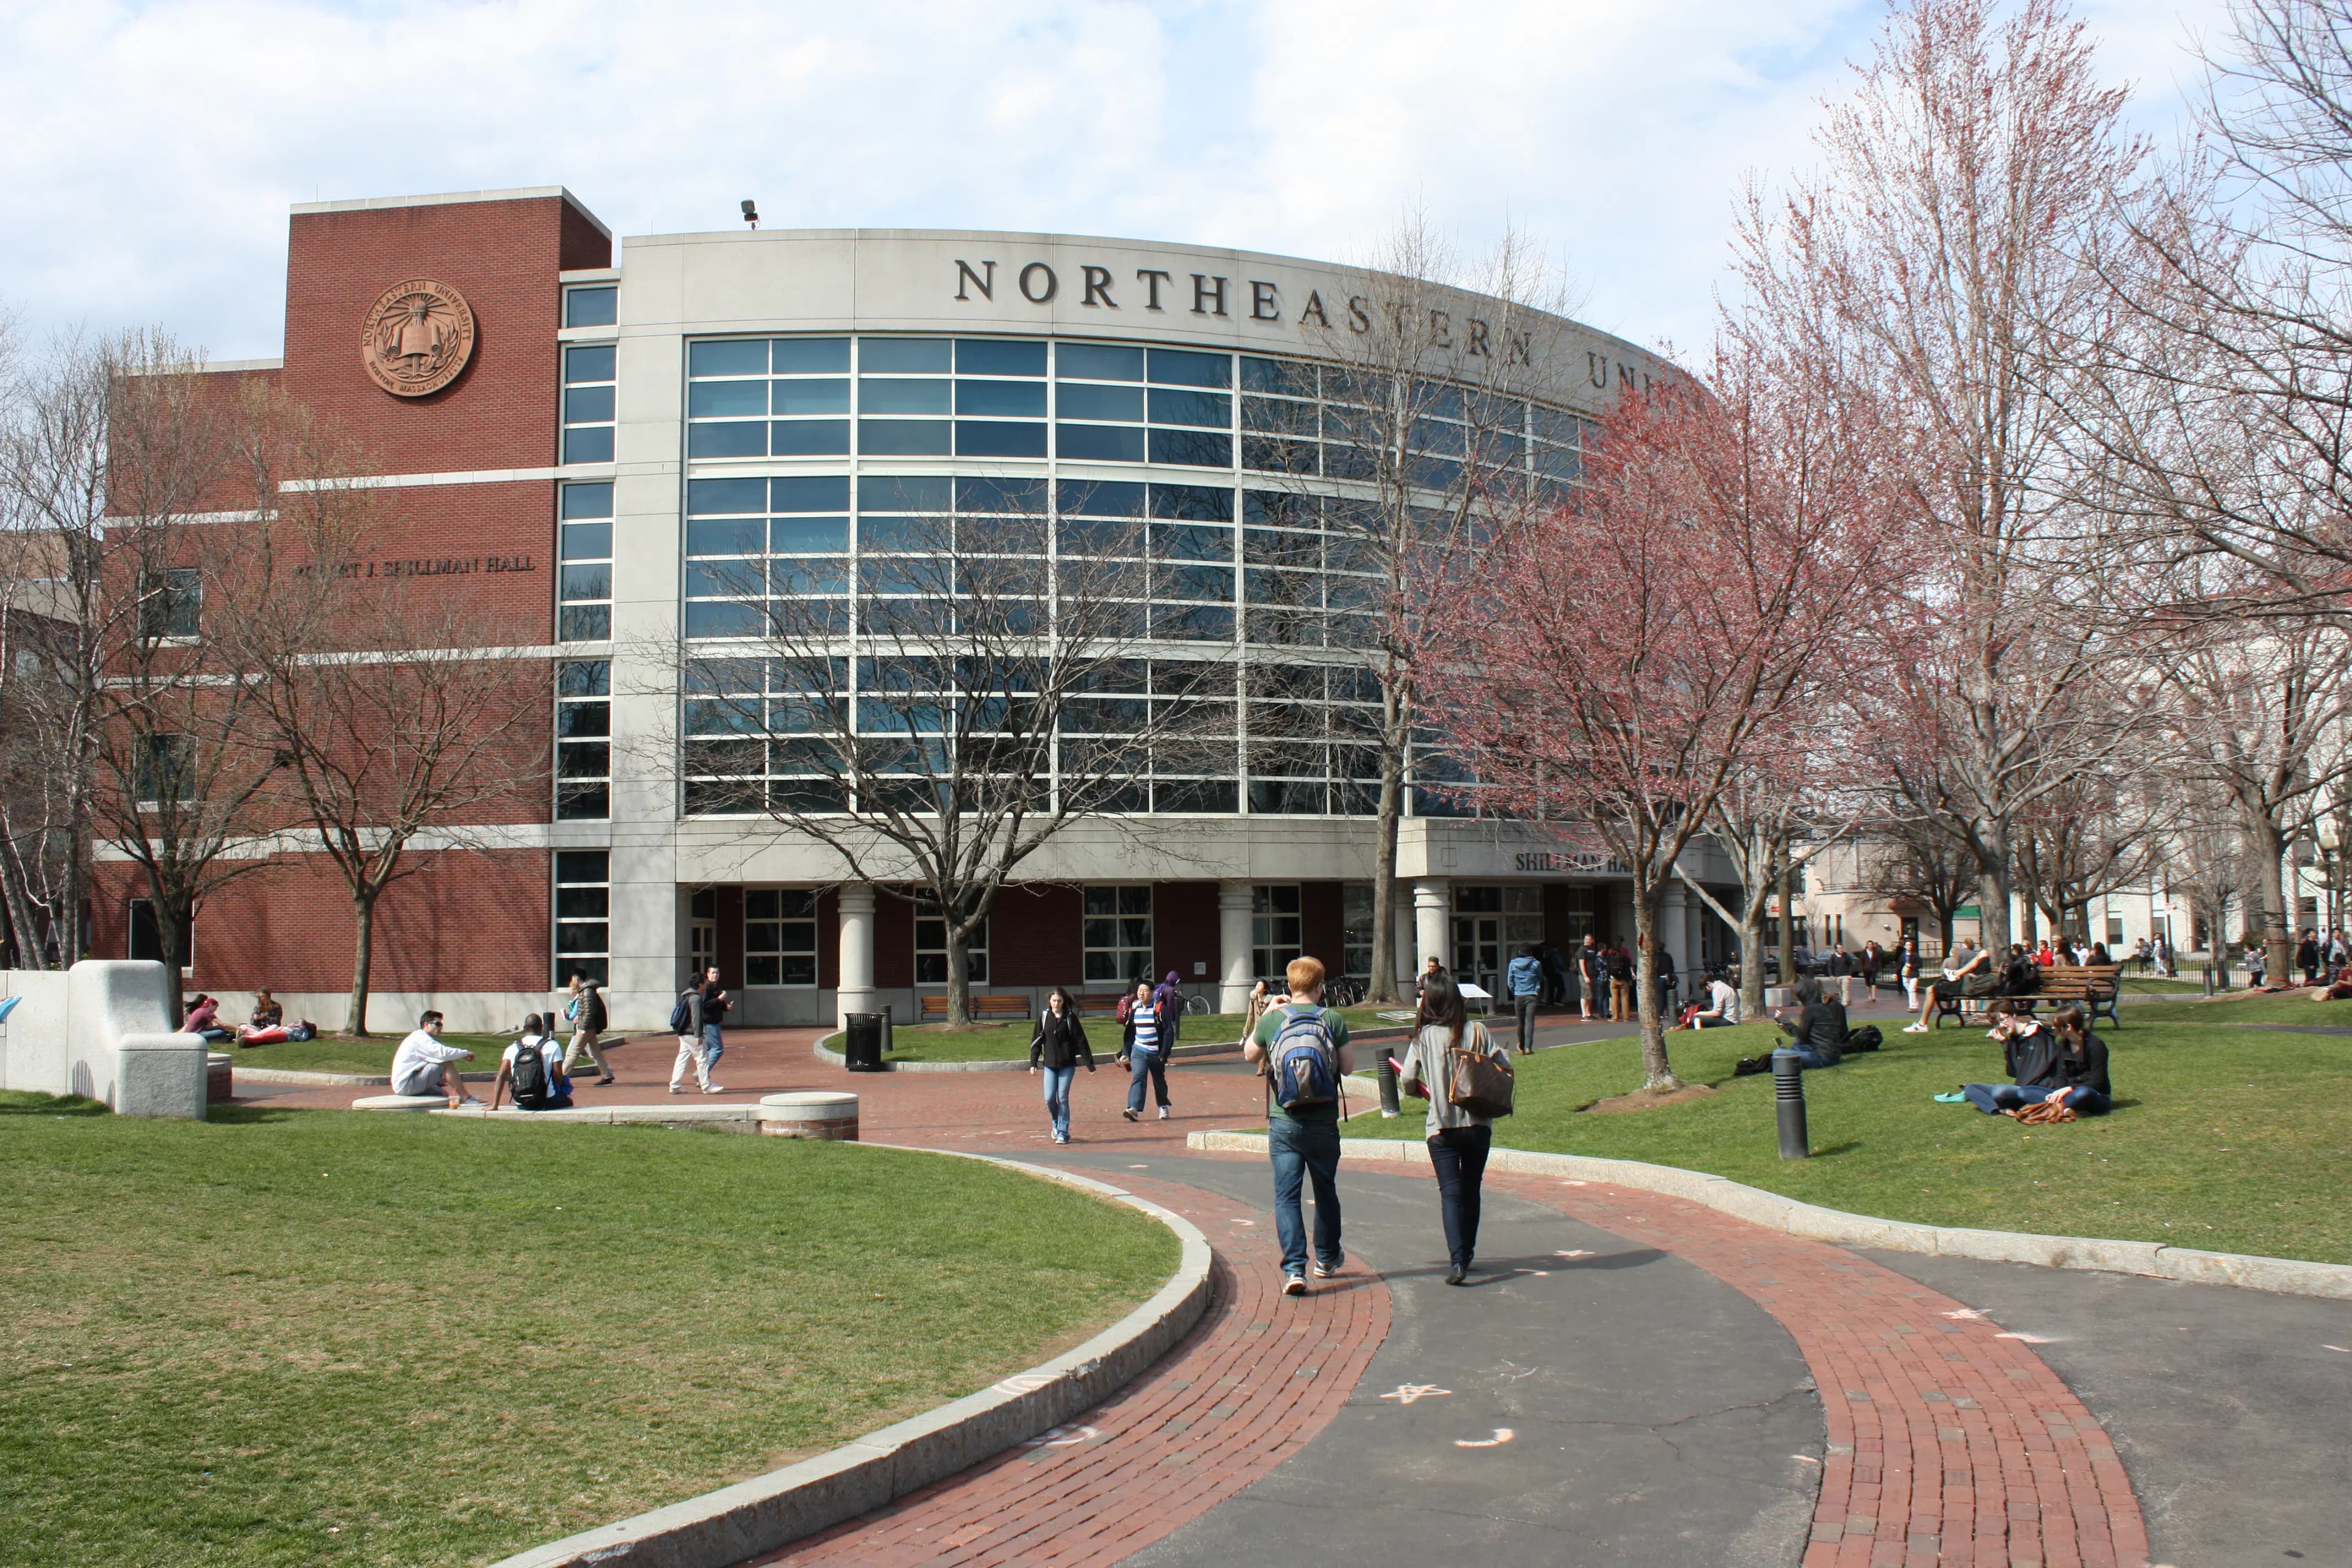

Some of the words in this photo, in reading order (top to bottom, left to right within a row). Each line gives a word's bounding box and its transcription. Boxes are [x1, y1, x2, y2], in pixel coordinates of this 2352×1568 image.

[363, 282, 426, 346] NORTHEASTERN
[435, 284, 471, 341] UNIVERSITY
[954, 259, 1531, 366] NORTHEASTERN
[382, 557, 478, 576] SHILLMAN
[484, 554, 535, 573] HALL
[1515, 853, 1602, 872] SHILLMAN
